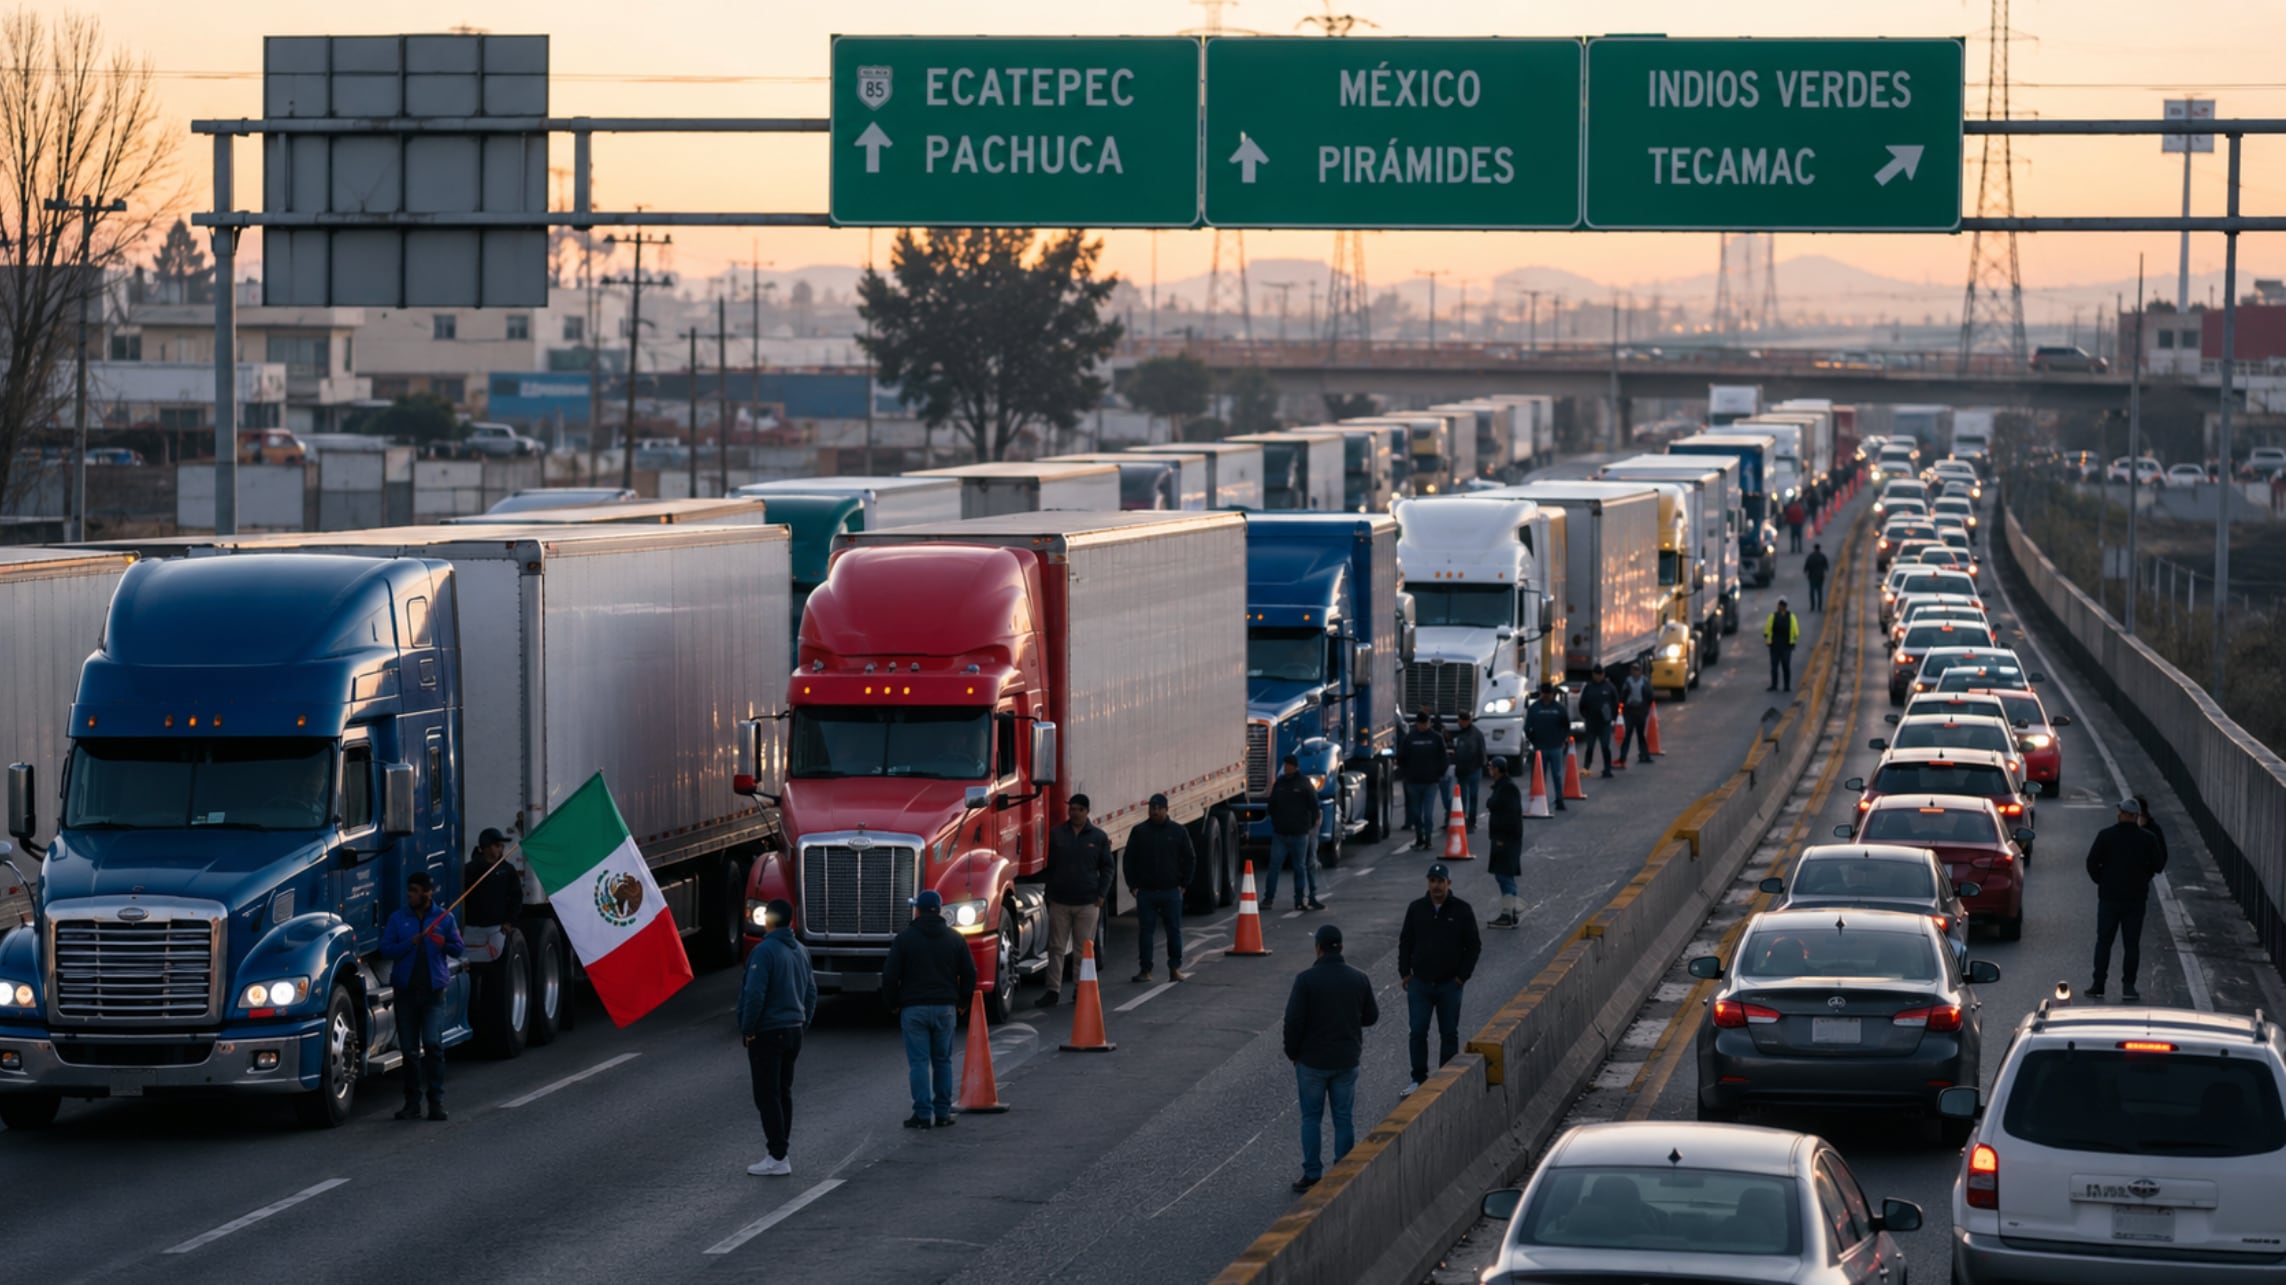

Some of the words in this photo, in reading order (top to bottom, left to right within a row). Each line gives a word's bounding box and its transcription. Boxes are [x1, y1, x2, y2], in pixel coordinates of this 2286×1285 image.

[865, 80, 885, 98] 85
[926, 67, 1134, 107] ECATEPEC
[1340, 61, 1481, 108] MÉXICO
[1648, 69, 1760, 108] INDIOS
[1776, 69, 1912, 108] VERDES
[926, 135, 1124, 174] PACHUCA
[1318, 137, 1515, 184] PIRÁMIDES
[1647, 147, 1816, 185] TECAMAC
